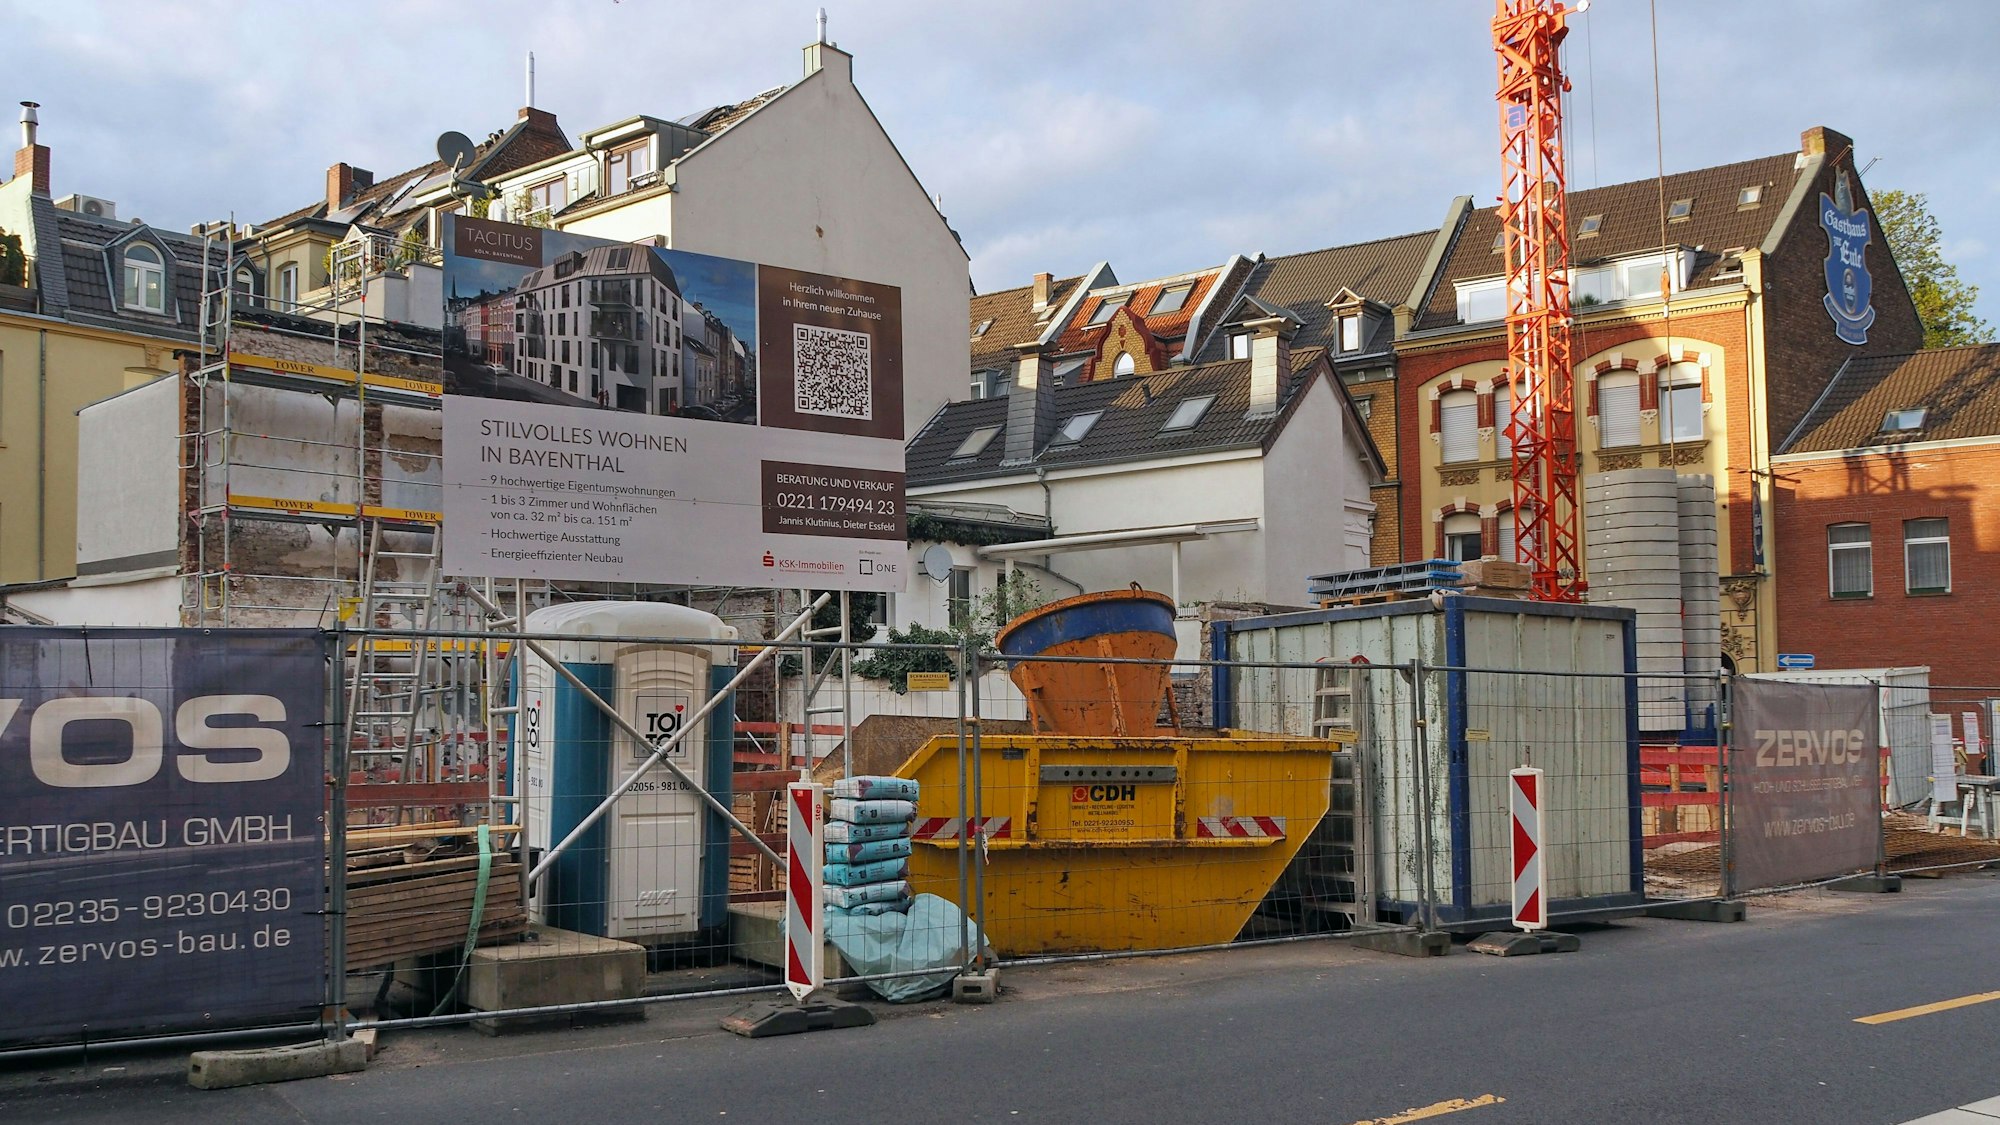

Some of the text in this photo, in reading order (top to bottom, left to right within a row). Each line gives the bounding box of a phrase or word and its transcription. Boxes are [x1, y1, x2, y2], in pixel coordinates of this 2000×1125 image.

[1824, 209, 1867, 239] Gasthaus
[465, 227, 534, 251] TACITUS
[474, 248, 491, 256] KÖLN,
[1840, 240, 1862, 269] Eule
[789, 281, 875, 304] Herzlich willkommen
[782, 296, 882, 320] in Ihrem neuen Zuhause
[274, 360, 316, 374] TOWER
[404, 380, 437, 393] TOWER
[480, 419, 687, 453] STILVOLLES WOHNEN
[481, 445, 625, 473] IN BAYENTHAL
[490, 475, 676, 498] 9 hochwertige Eigentumswohnungen
[776, 473, 895, 492] BERATUNG UND VERKAUF
[273, 499, 314, 510] TOWER
[491, 495, 657, 515] 1 bis 3 Zimmer und Wohnflächen
[777, 492, 895, 515] 0221 179494 23
[404, 510, 437, 521] TOWER
[490, 511, 633, 526] von ca. 32 m² bis ca. 151 m²
[778, 516, 895, 531] Jannis Klutinius, Dieter Essfeld
[491, 528, 621, 546] Hochwertige Ausstattung
[491, 548, 624, 563] Energieeffizienter Neubau
[779, 559, 845, 571] KSK-Immobilien
[876, 563, 897, 573] ONE
[0, 694, 290, 788] OS
[1754, 729, 1864, 768] ZERVOS
[661, 781, 678, 791] 981
[1090, 784, 1136, 802] CDH
[0, 814, 293, 856] RTIGBAU GMBH
[7, 887, 291, 929] 02235-9230430
